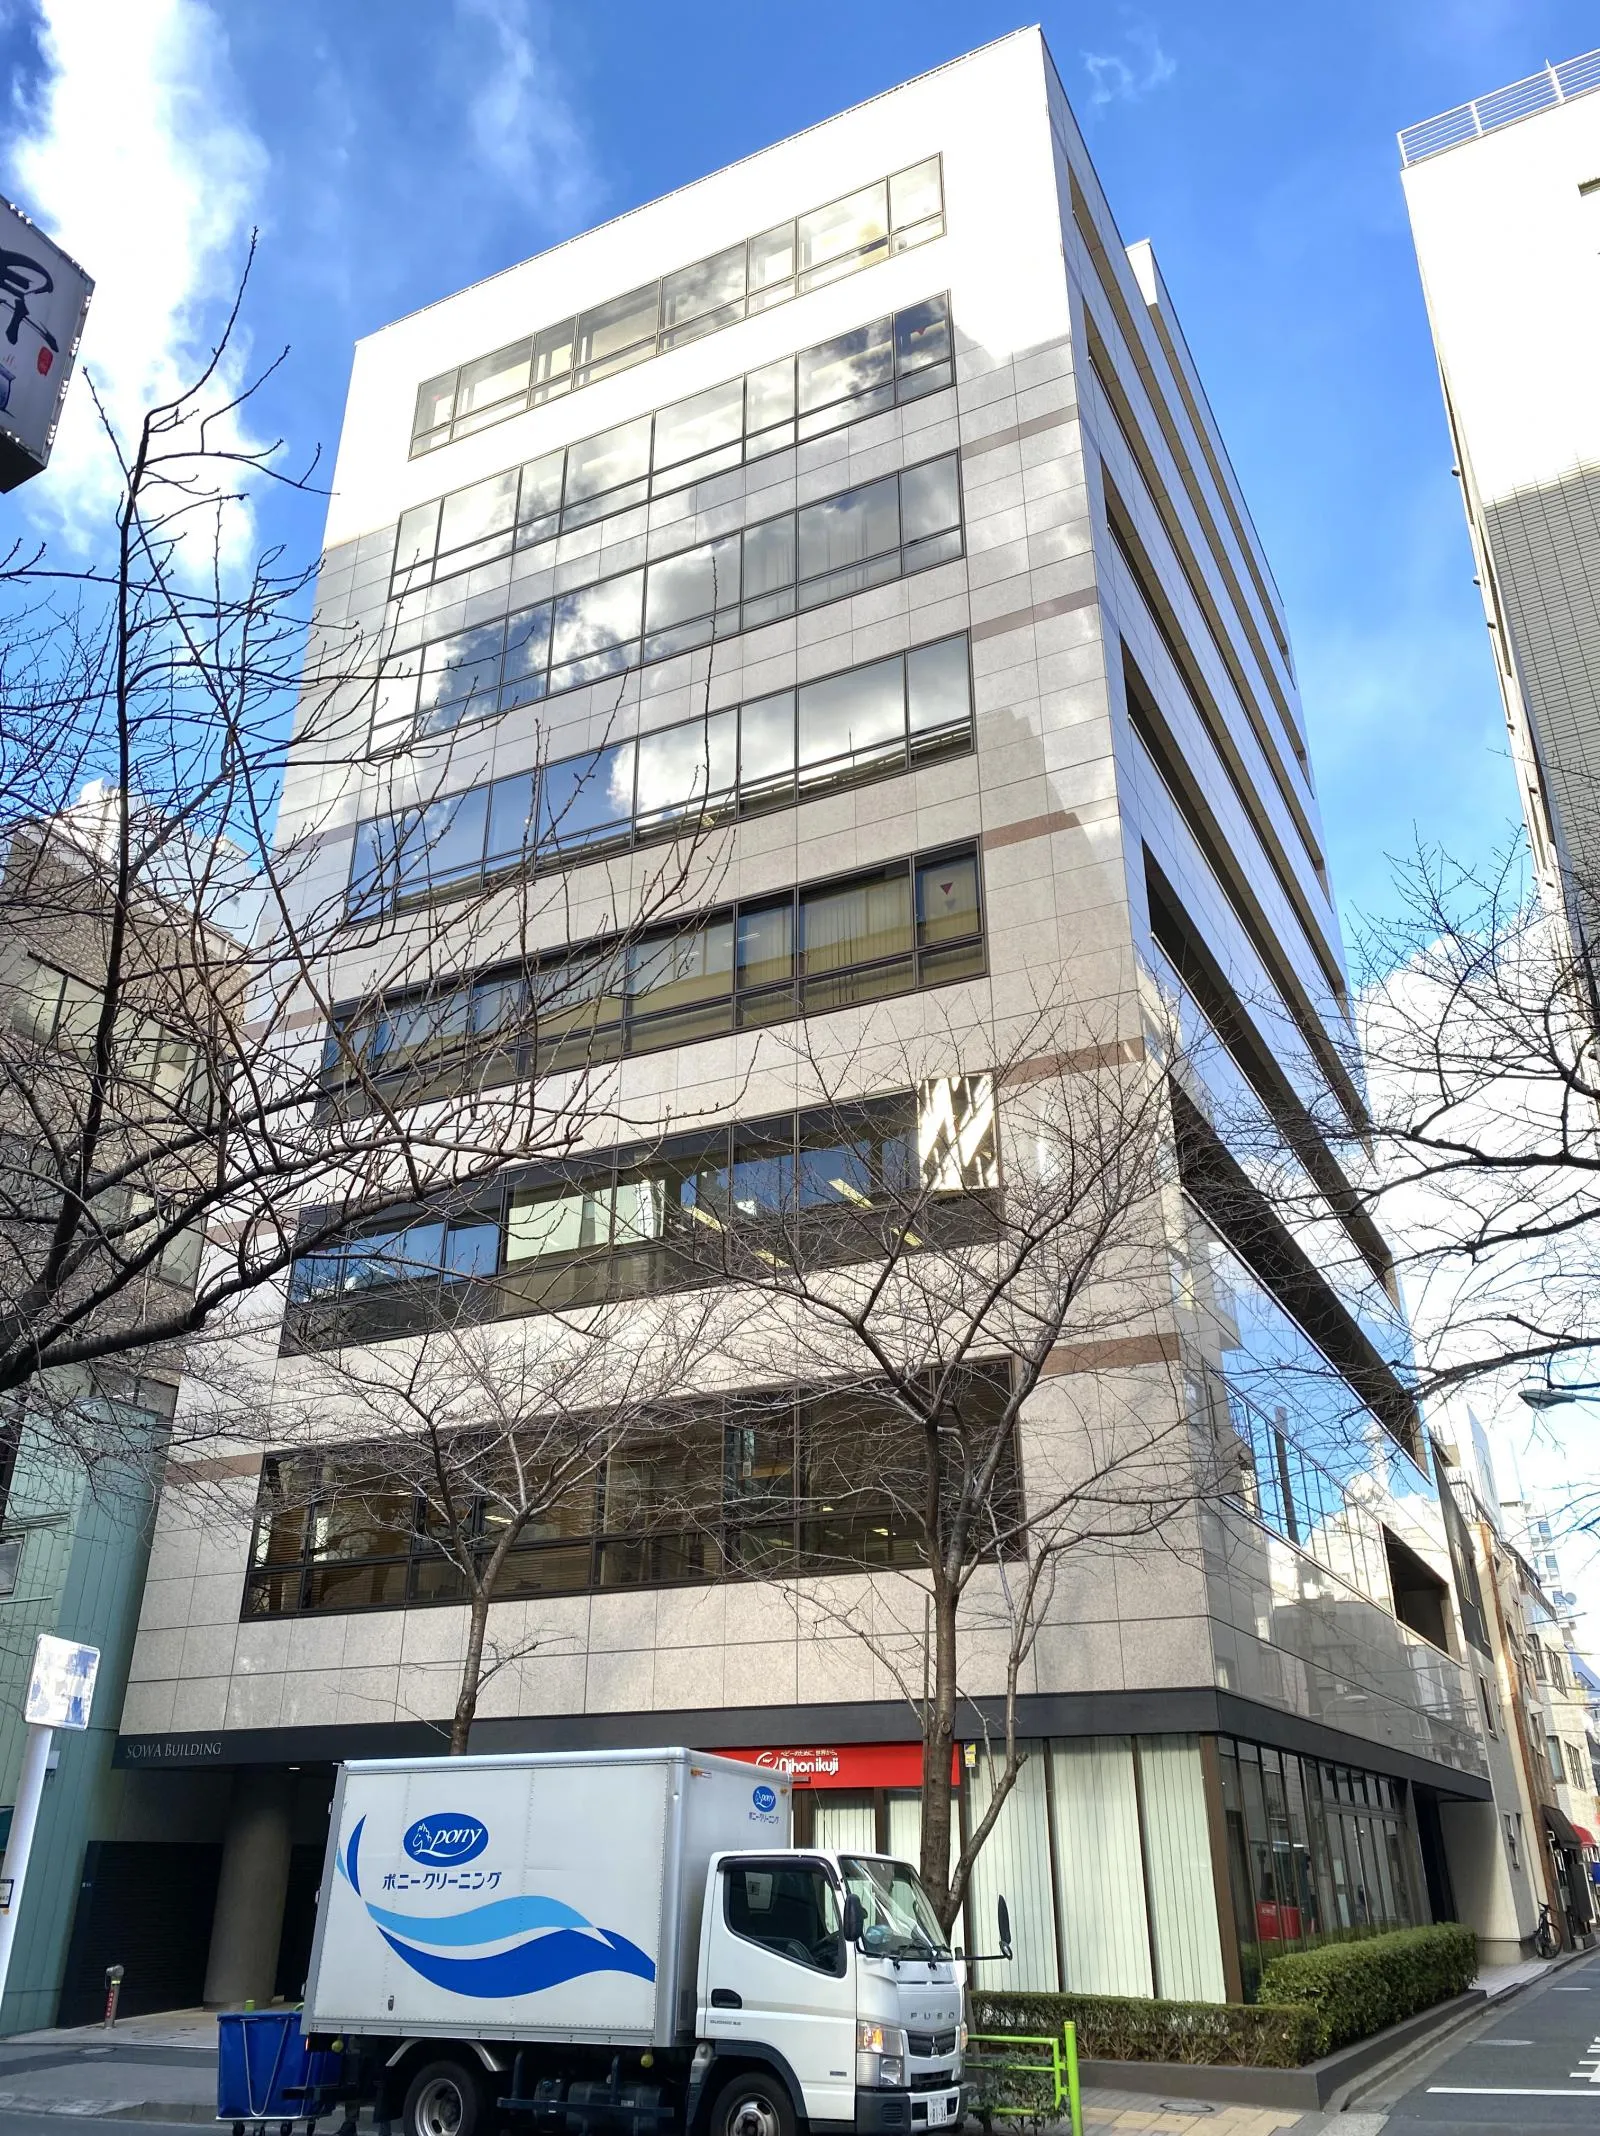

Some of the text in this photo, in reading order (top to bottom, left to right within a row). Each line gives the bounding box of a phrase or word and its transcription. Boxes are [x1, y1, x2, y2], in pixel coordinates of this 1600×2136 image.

[126, 1743, 221, 1758] SOWA BUILDING
[815, 1757, 839, 1776] ikuji
[424, 1828, 483, 1857] pony
[382, 1871, 502, 1891] ポニークリーニング
